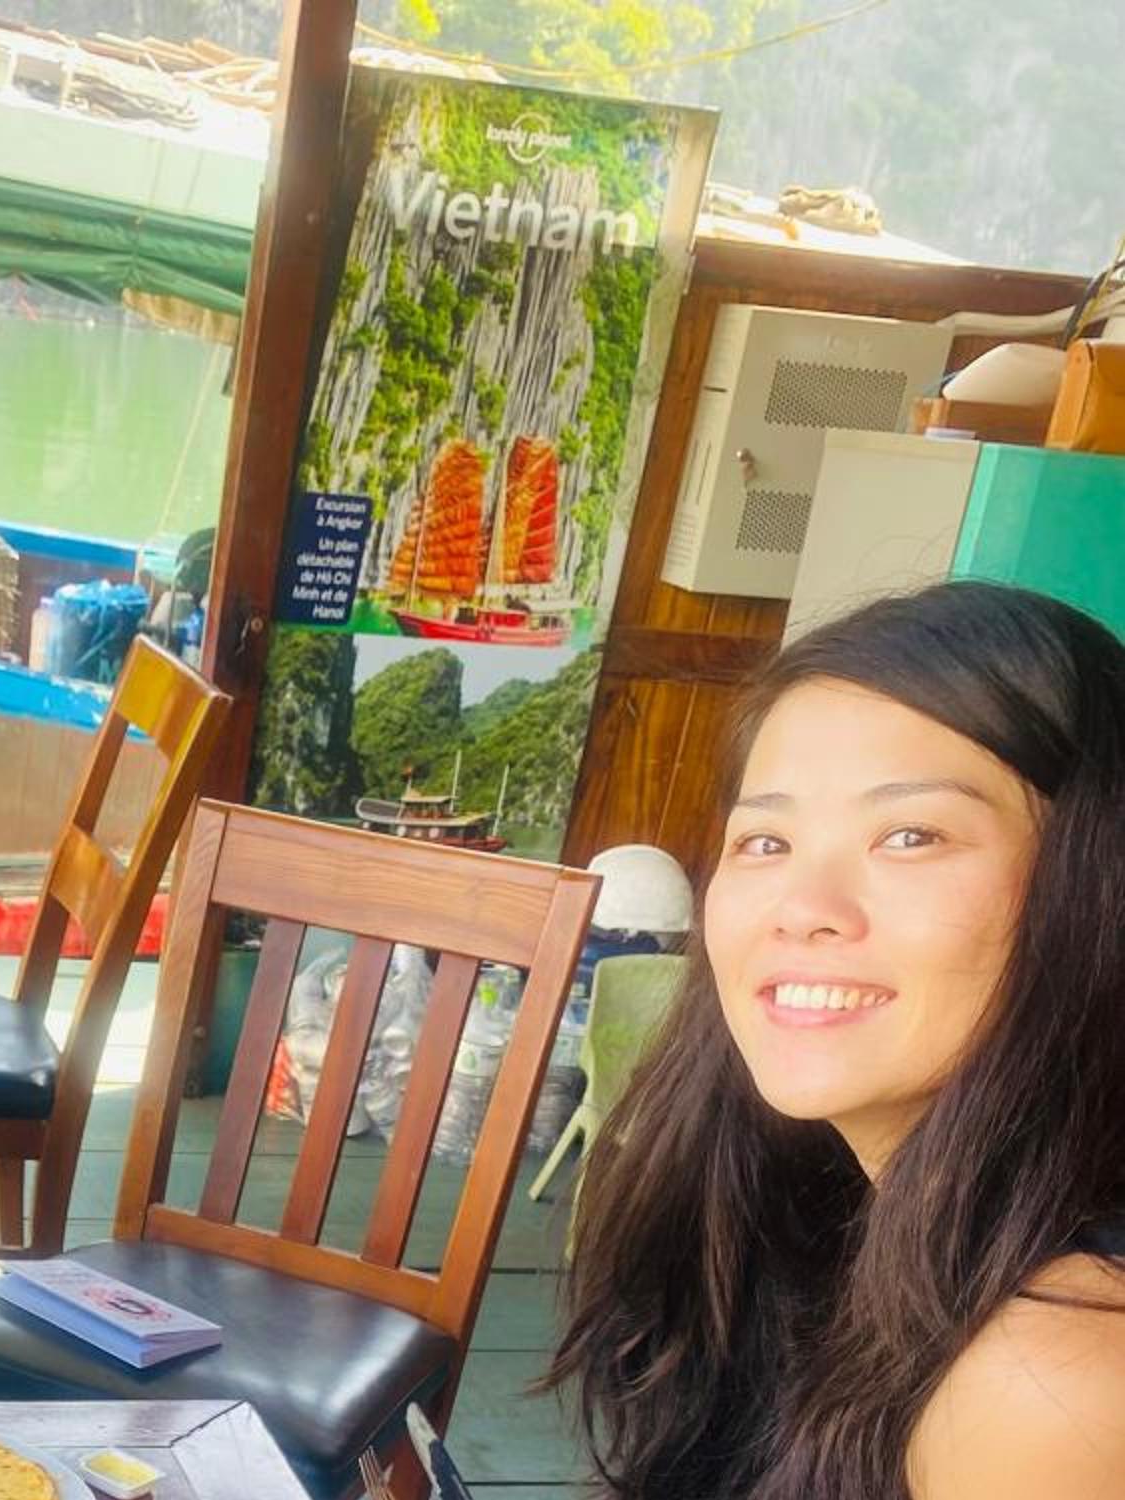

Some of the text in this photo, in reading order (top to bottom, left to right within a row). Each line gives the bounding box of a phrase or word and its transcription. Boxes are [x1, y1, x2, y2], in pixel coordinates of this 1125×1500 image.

[485, 123, 572, 149] lonely planet
[387, 169, 639, 259] Vietnam
[315, 497, 366, 513] Excursion
[325, 514, 364, 531] Angkor
[318, 538, 359, 554] Un plan
[300, 569, 315, 583] de
[333, 571, 352, 585] Chi
[292, 584, 348, 602] Minh et de
[312, 602, 345, 619] Hanoi
